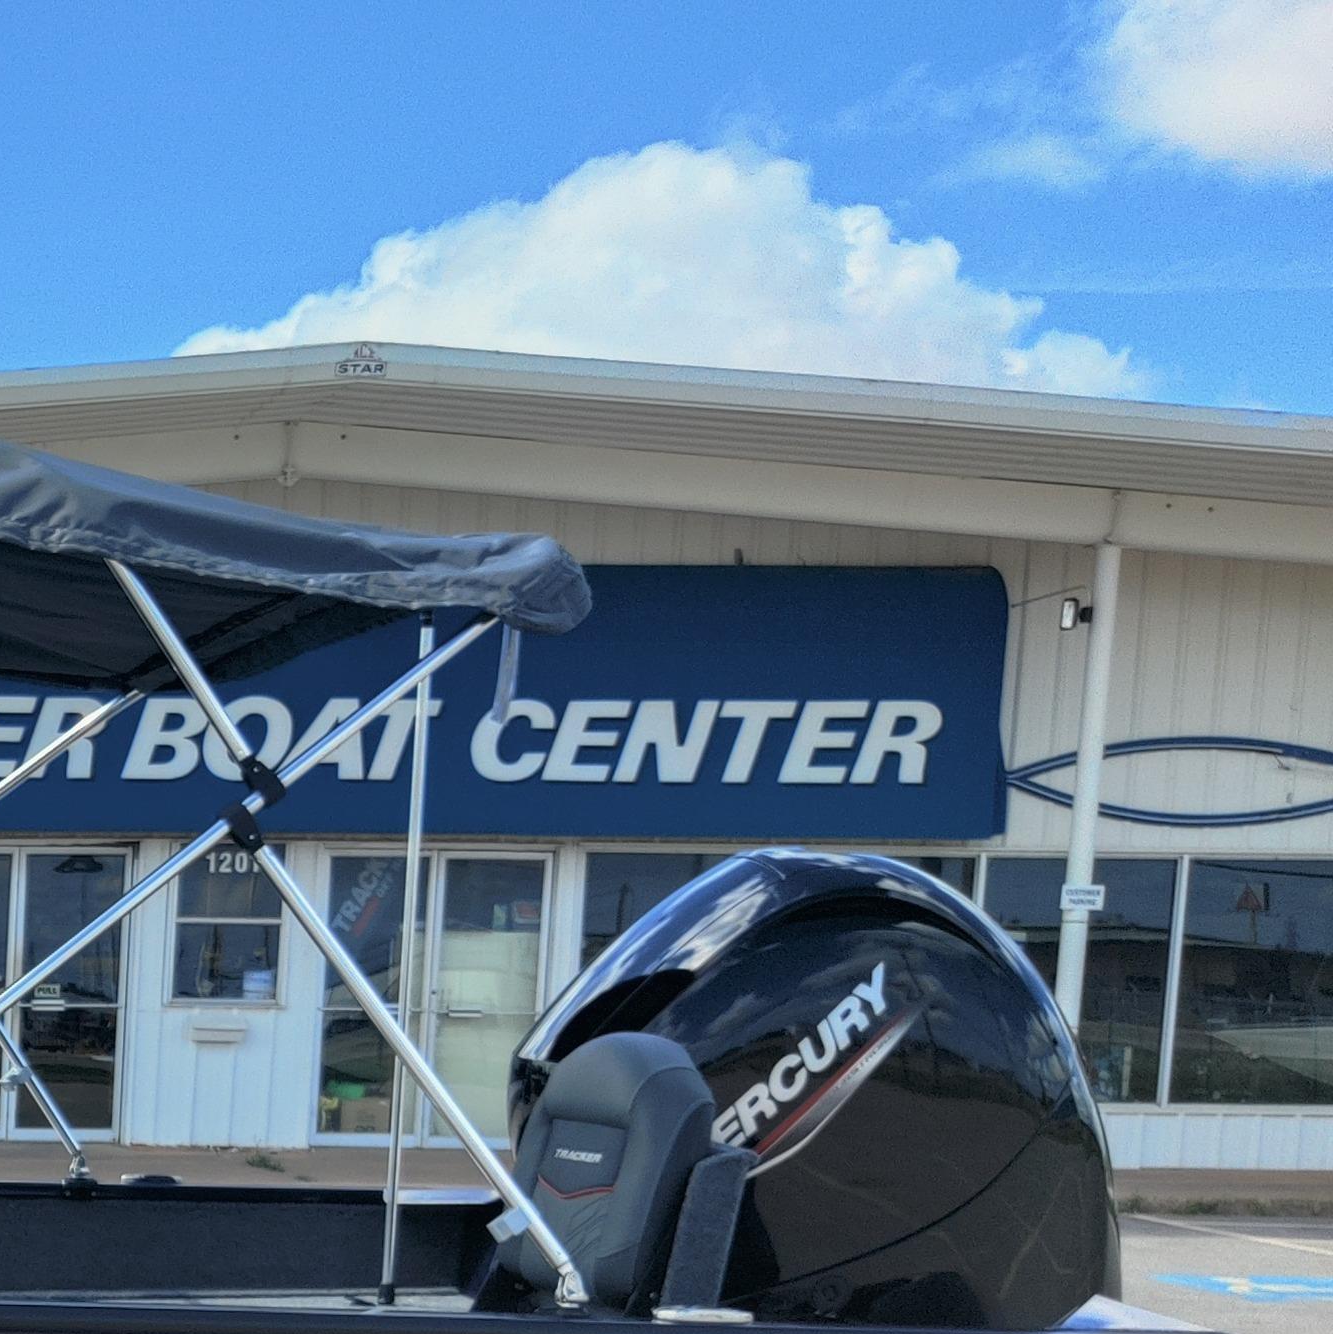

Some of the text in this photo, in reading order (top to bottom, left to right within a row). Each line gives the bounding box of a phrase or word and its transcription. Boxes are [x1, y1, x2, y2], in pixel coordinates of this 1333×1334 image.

[337, 363, 384, 374] STAR
[120, 696, 443, 781] BOAT
[470, 699, 943, 784] CENTER
[37, 987, 57, 995] PULL
[710, 961, 886, 1147] ERCURY
[554, 1148, 603, 1163] TRACKER
